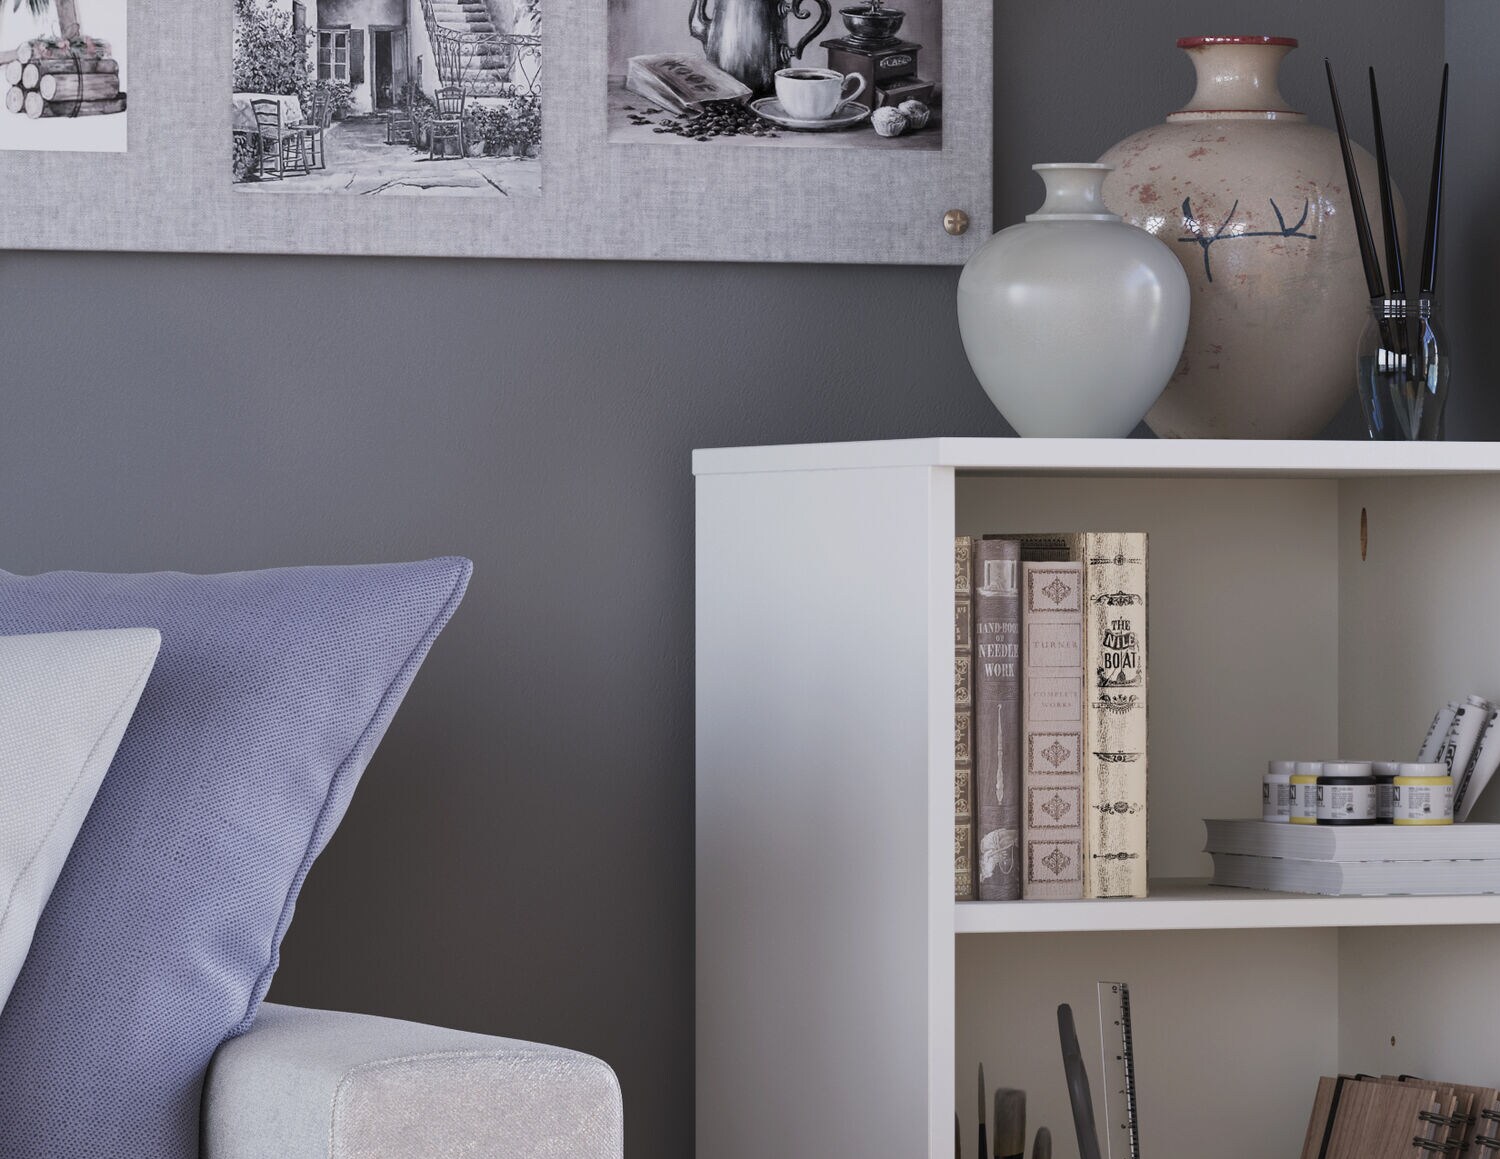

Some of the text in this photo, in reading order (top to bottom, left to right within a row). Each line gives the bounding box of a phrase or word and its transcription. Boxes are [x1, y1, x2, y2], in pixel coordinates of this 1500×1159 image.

[1111, 619, 1131, 631] THE
[1032, 641, 1079, 649] TURNER
[1105, 632, 1136, 650] NILE
[979, 643, 1020, 658] NEEDLE
[1104, 652, 1137, 669] BOAT
[985, 663, 1015, 677] WORK
